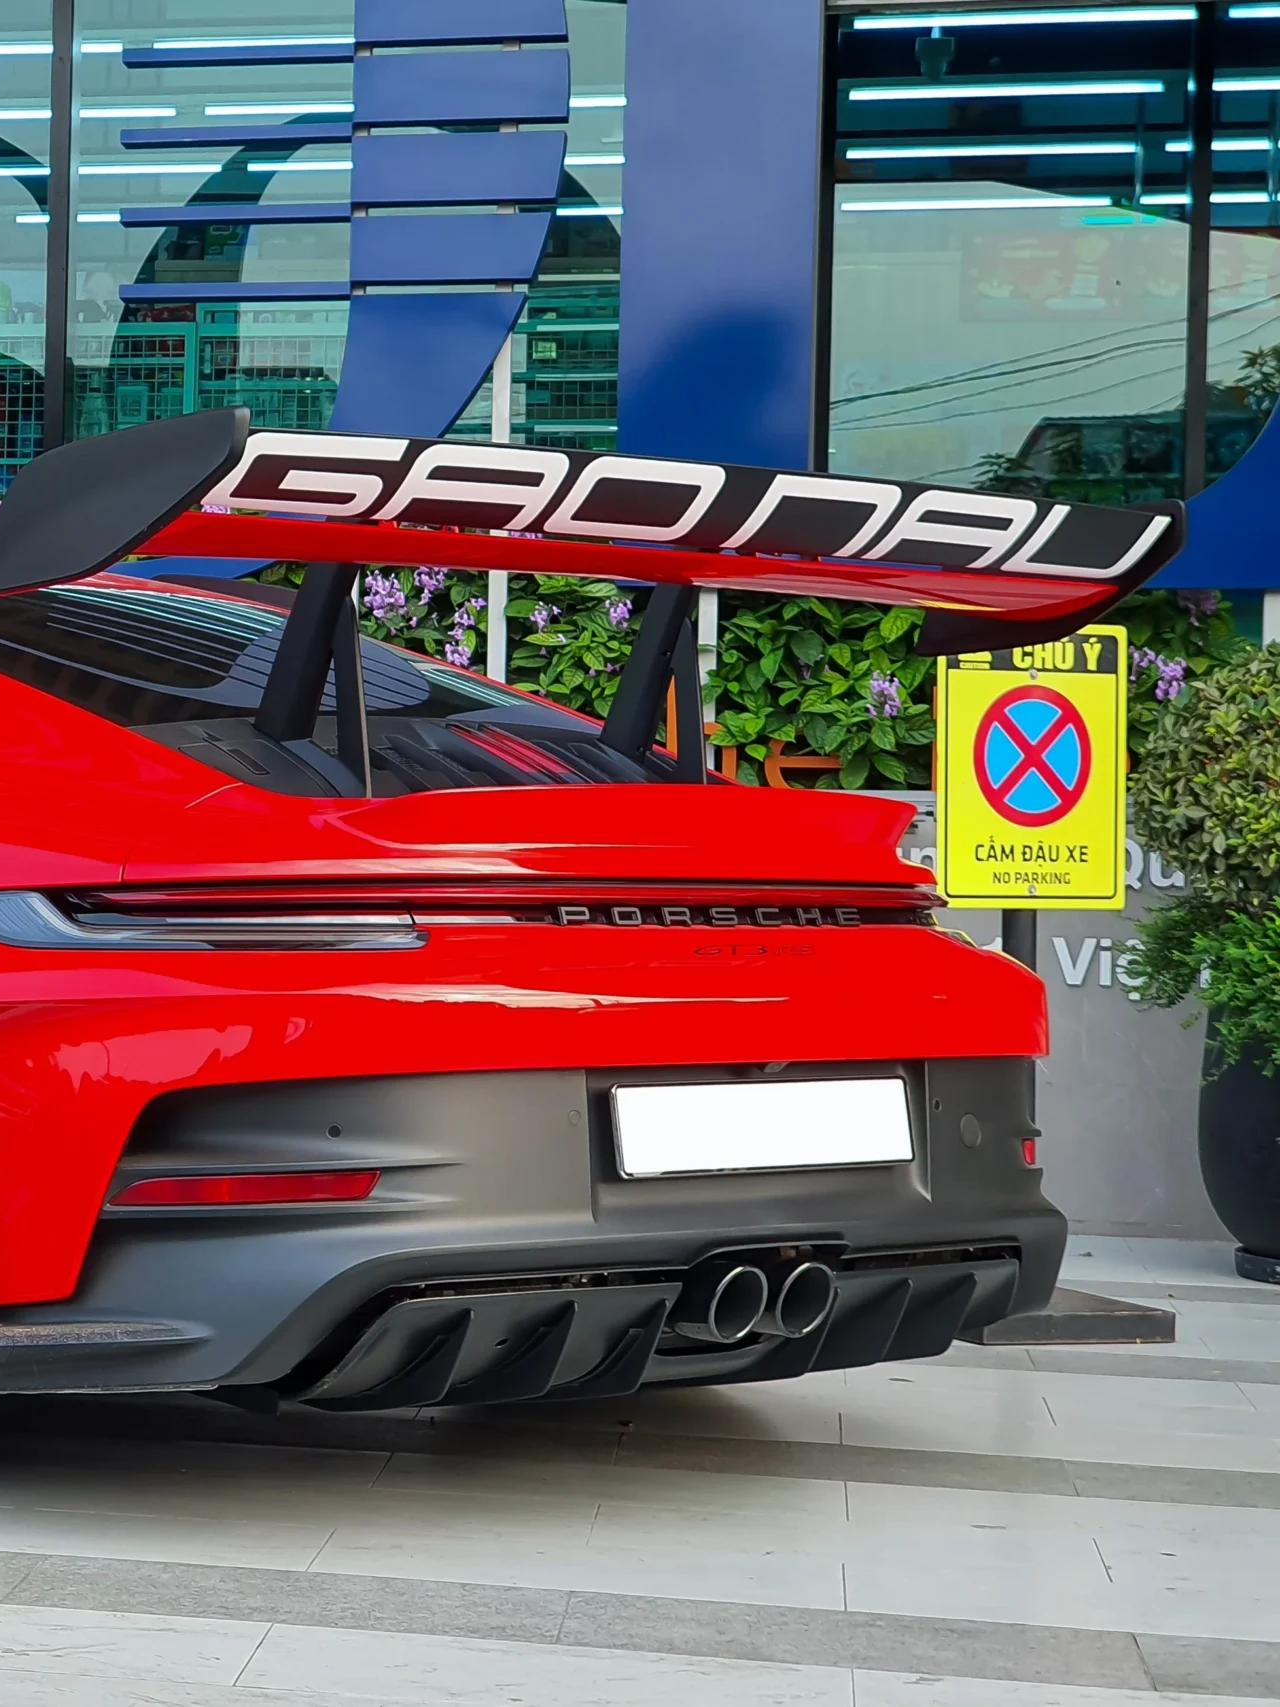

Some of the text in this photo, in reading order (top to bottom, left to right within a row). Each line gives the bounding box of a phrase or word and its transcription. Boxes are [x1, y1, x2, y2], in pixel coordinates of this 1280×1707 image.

[195, 431, 728, 543] GAO
[1081, 636, 1103, 671] Ý
[1065, 845, 1089, 863] XE
[992, 871, 1071, 885] NO PARKING
[557, 905, 861, 926] PORSCHE
